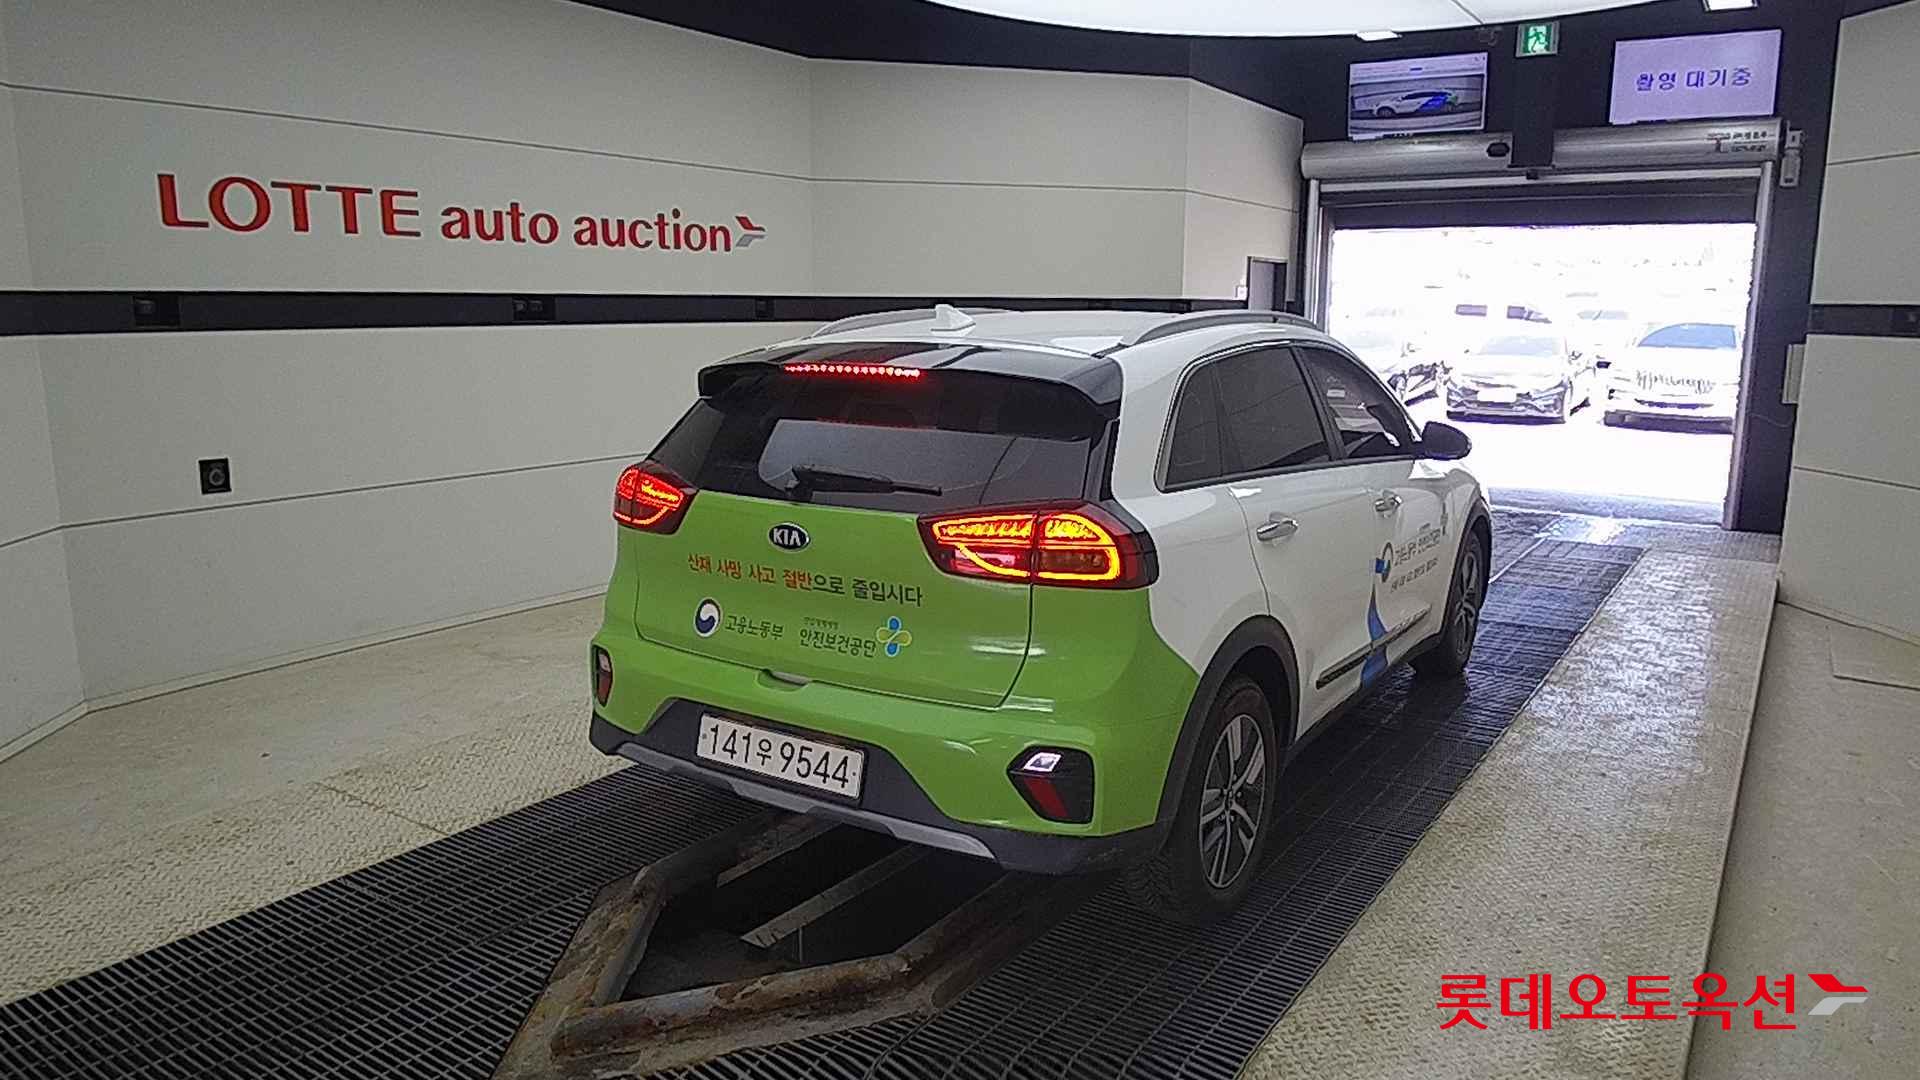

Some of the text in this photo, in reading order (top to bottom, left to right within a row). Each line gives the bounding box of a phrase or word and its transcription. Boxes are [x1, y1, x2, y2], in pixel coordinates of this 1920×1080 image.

[1636, 72, 1676, 92] 촬영
[156, 173, 732, 252] LOTTE auto auction
[772, 528, 801, 546] KIA
[688, 553, 923, 607] 산재 사망 사고 절반으로 줄입시다
[726, 614, 783, 641] 고용노동부
[800, 628, 876, 658] 안전보건공단
